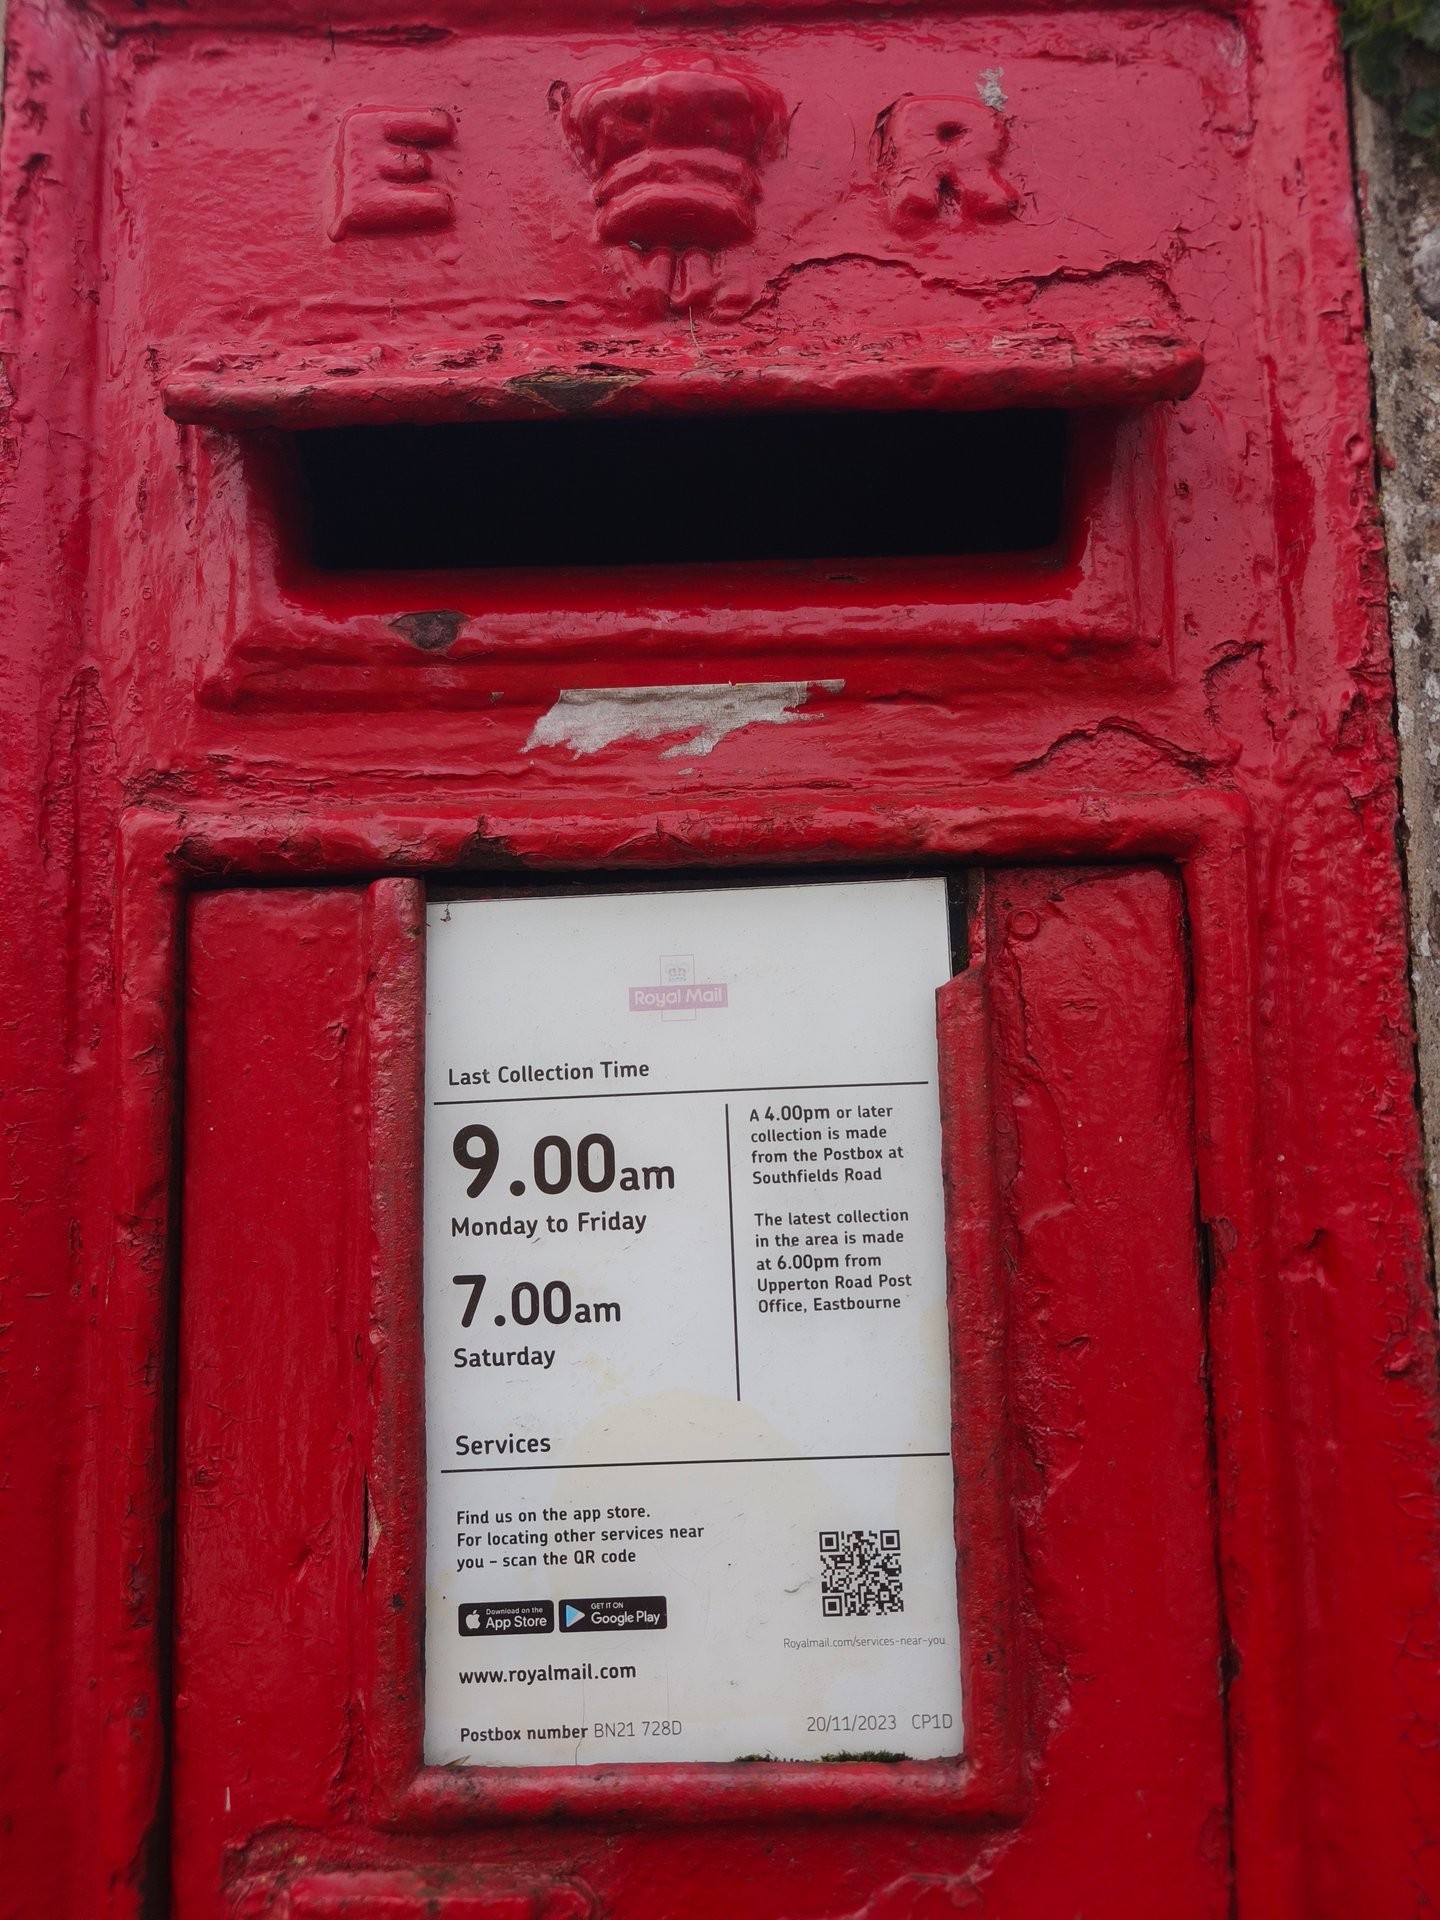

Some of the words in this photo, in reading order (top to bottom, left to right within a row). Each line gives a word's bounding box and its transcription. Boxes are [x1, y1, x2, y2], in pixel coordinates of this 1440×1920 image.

[328, 104, 456, 241] E
[876, 92, 1020, 224] R
[634, 990, 682, 1007] Royal
[686, 986, 723, 1003] Mail
[449, 1068, 490, 1086] Last
[498, 1063, 593, 1083] Collection
[600, 1061, 649, 1078] Time
[750, 1109, 759, 1122] A
[765, 1105, 830, 1123] 4.00pm
[837, 1109, 852, 1118] or
[858, 1105, 893, 1118] later
[751, 1129, 821, 1142] collection
[828, 1127, 839, 1140] is
[846, 1125, 886, 1139] made
[453, 1124, 674, 1198] 9.00am
[752, 1150, 787, 1163] from
[793, 1149, 817, 1162] the
[824, 1147, 882, 1161] Postbox
[889, 1147, 904, 1158] at
[753, 1169, 838, 1184] Southfields
[845, 1167, 882, 1183] Road
[452, 1216, 538, 1238] Monday
[546, 1216, 568, 1233] to
[578, 1211, 646, 1234] Friday
[754, 1213, 782, 1226] The
[789, 1212, 831, 1225] latest
[837, 1208, 908, 1223] collection
[756, 1234, 769, 1247] in
[775, 1234, 799, 1247] the
[805, 1235, 838, 1245] area
[845, 1235, 856, 1244] is
[862, 1230, 903, 1243] made
[757, 1258, 772, 1270] at
[778, 1254, 839, 1271] 6.00pm
[845, 1254, 881, 1267] from
[758, 1278, 828, 1294] Upperton
[835, 1275, 872, 1289] Road
[879, 1274, 912, 1287] Post
[453, 1274, 620, 1328] 7.00am
[759, 1299, 807, 1313] Office,
[814, 1297, 900, 1311] Eastbourne
[454, 1346, 555, 1369] Saturday
[456, 1433, 551, 1456] Services
[457, 1510, 489, 1525] Find
[496, 1513, 512, 1523] us
[519, 1512, 536, 1522] on
[543, 1508, 567, 1521] the
[574, 1509, 600, 1523] app
[607, 1506, 650, 1518] store.
[458, 1533, 482, 1547] For
[488, 1530, 548, 1549] locating
[554, 1529, 595, 1543] other
[601, 1526, 663, 1541] services
[670, 1527, 704, 1538] near
[457, 1558, 484, 1572] you
[503, 1556, 536, 1567] scan
[543, 1552, 567, 1565] the
[574, 1550, 595, 1564] QR
[602, 1549, 636, 1563] code
[532, 1606, 543, 1614] the
[613, 1601, 624, 1609] ON
[486, 1617, 511, 1630] App
[514, 1616, 547, 1627] Store
[591, 1611, 634, 1626] Google
[637, 1611, 660, 1625] Play
[784, 1635, 946, 1650] Royalmail.com/services-near-you
[459, 1663, 636, 1685] www.royalmail.com
[461, 1727, 521, 1742] Postbox
[527, 1725, 588, 1740] number
[594, 1722, 635, 1738] BN21
[642, 1720, 682, 1736] 728D
[807, 1715, 896, 1732] 20/11/2023
[912, 1714, 953, 1729] CP1D
